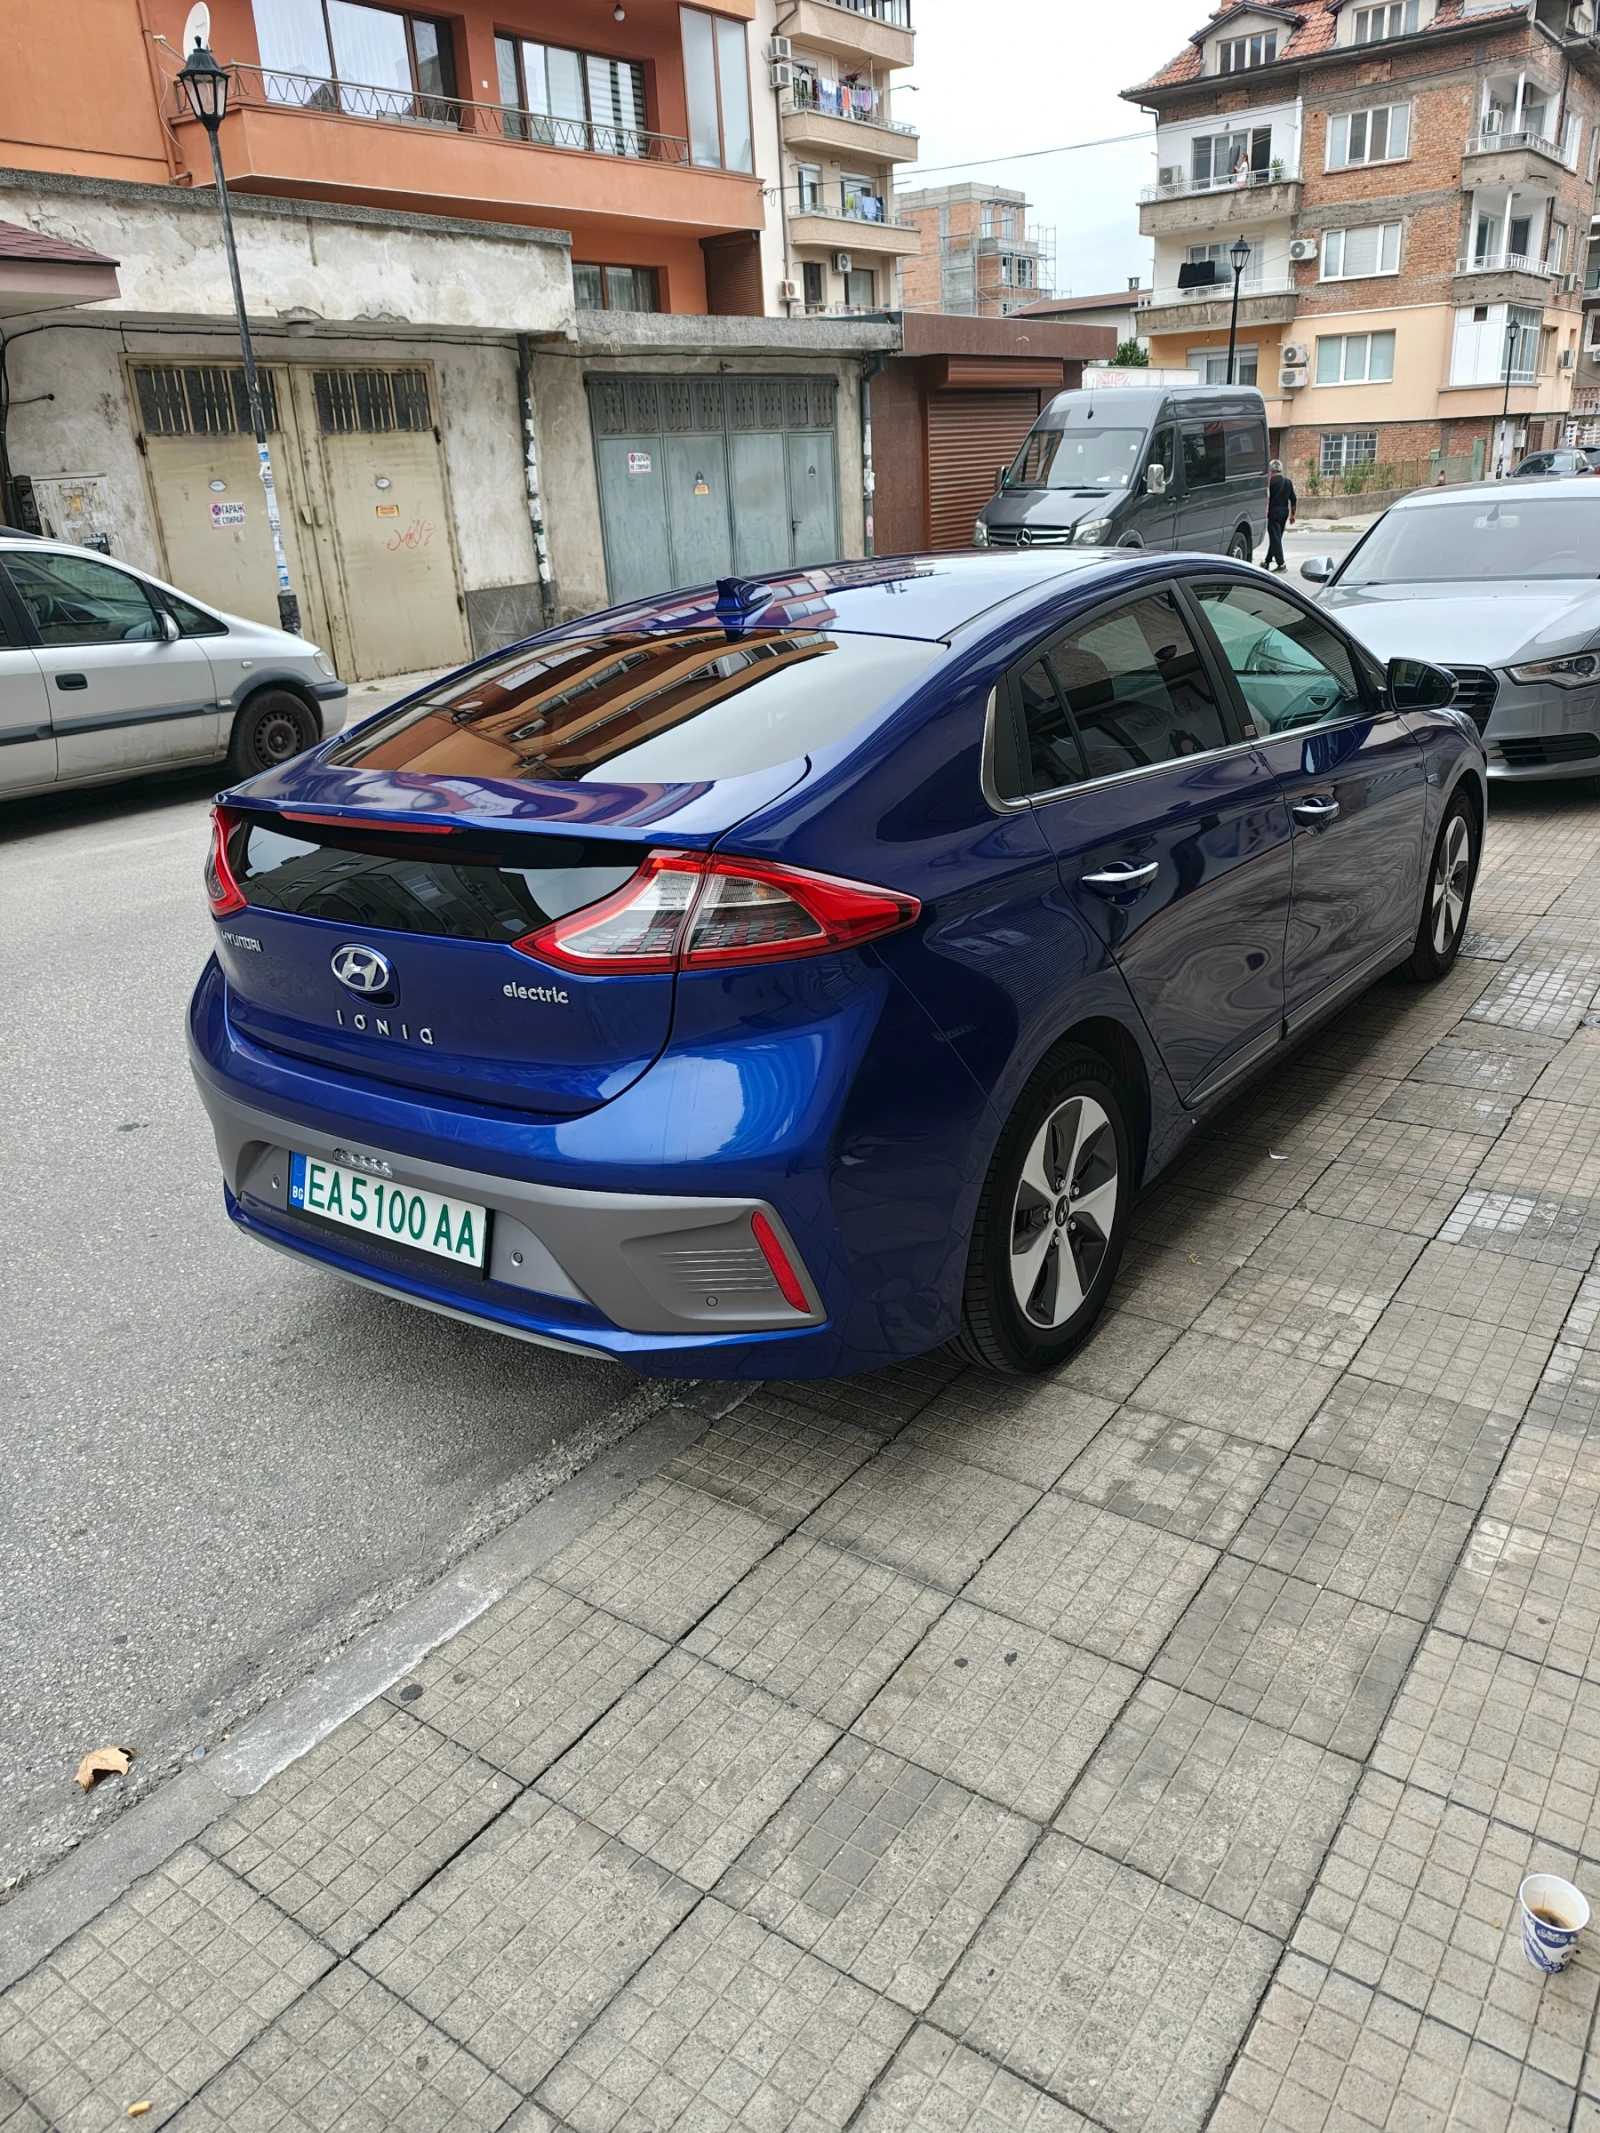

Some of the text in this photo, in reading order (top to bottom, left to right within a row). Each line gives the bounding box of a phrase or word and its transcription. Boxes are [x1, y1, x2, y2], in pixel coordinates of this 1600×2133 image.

[221, 504, 245, 514] ГАРАЖ
[213, 517, 221, 525] НЕ
[221, 931, 262, 952] HYUNDAI
[503, 982, 569, 1004] electric
[336, 1009, 435, 1045] IONIQ
[292, 1185, 304, 1200] BG
